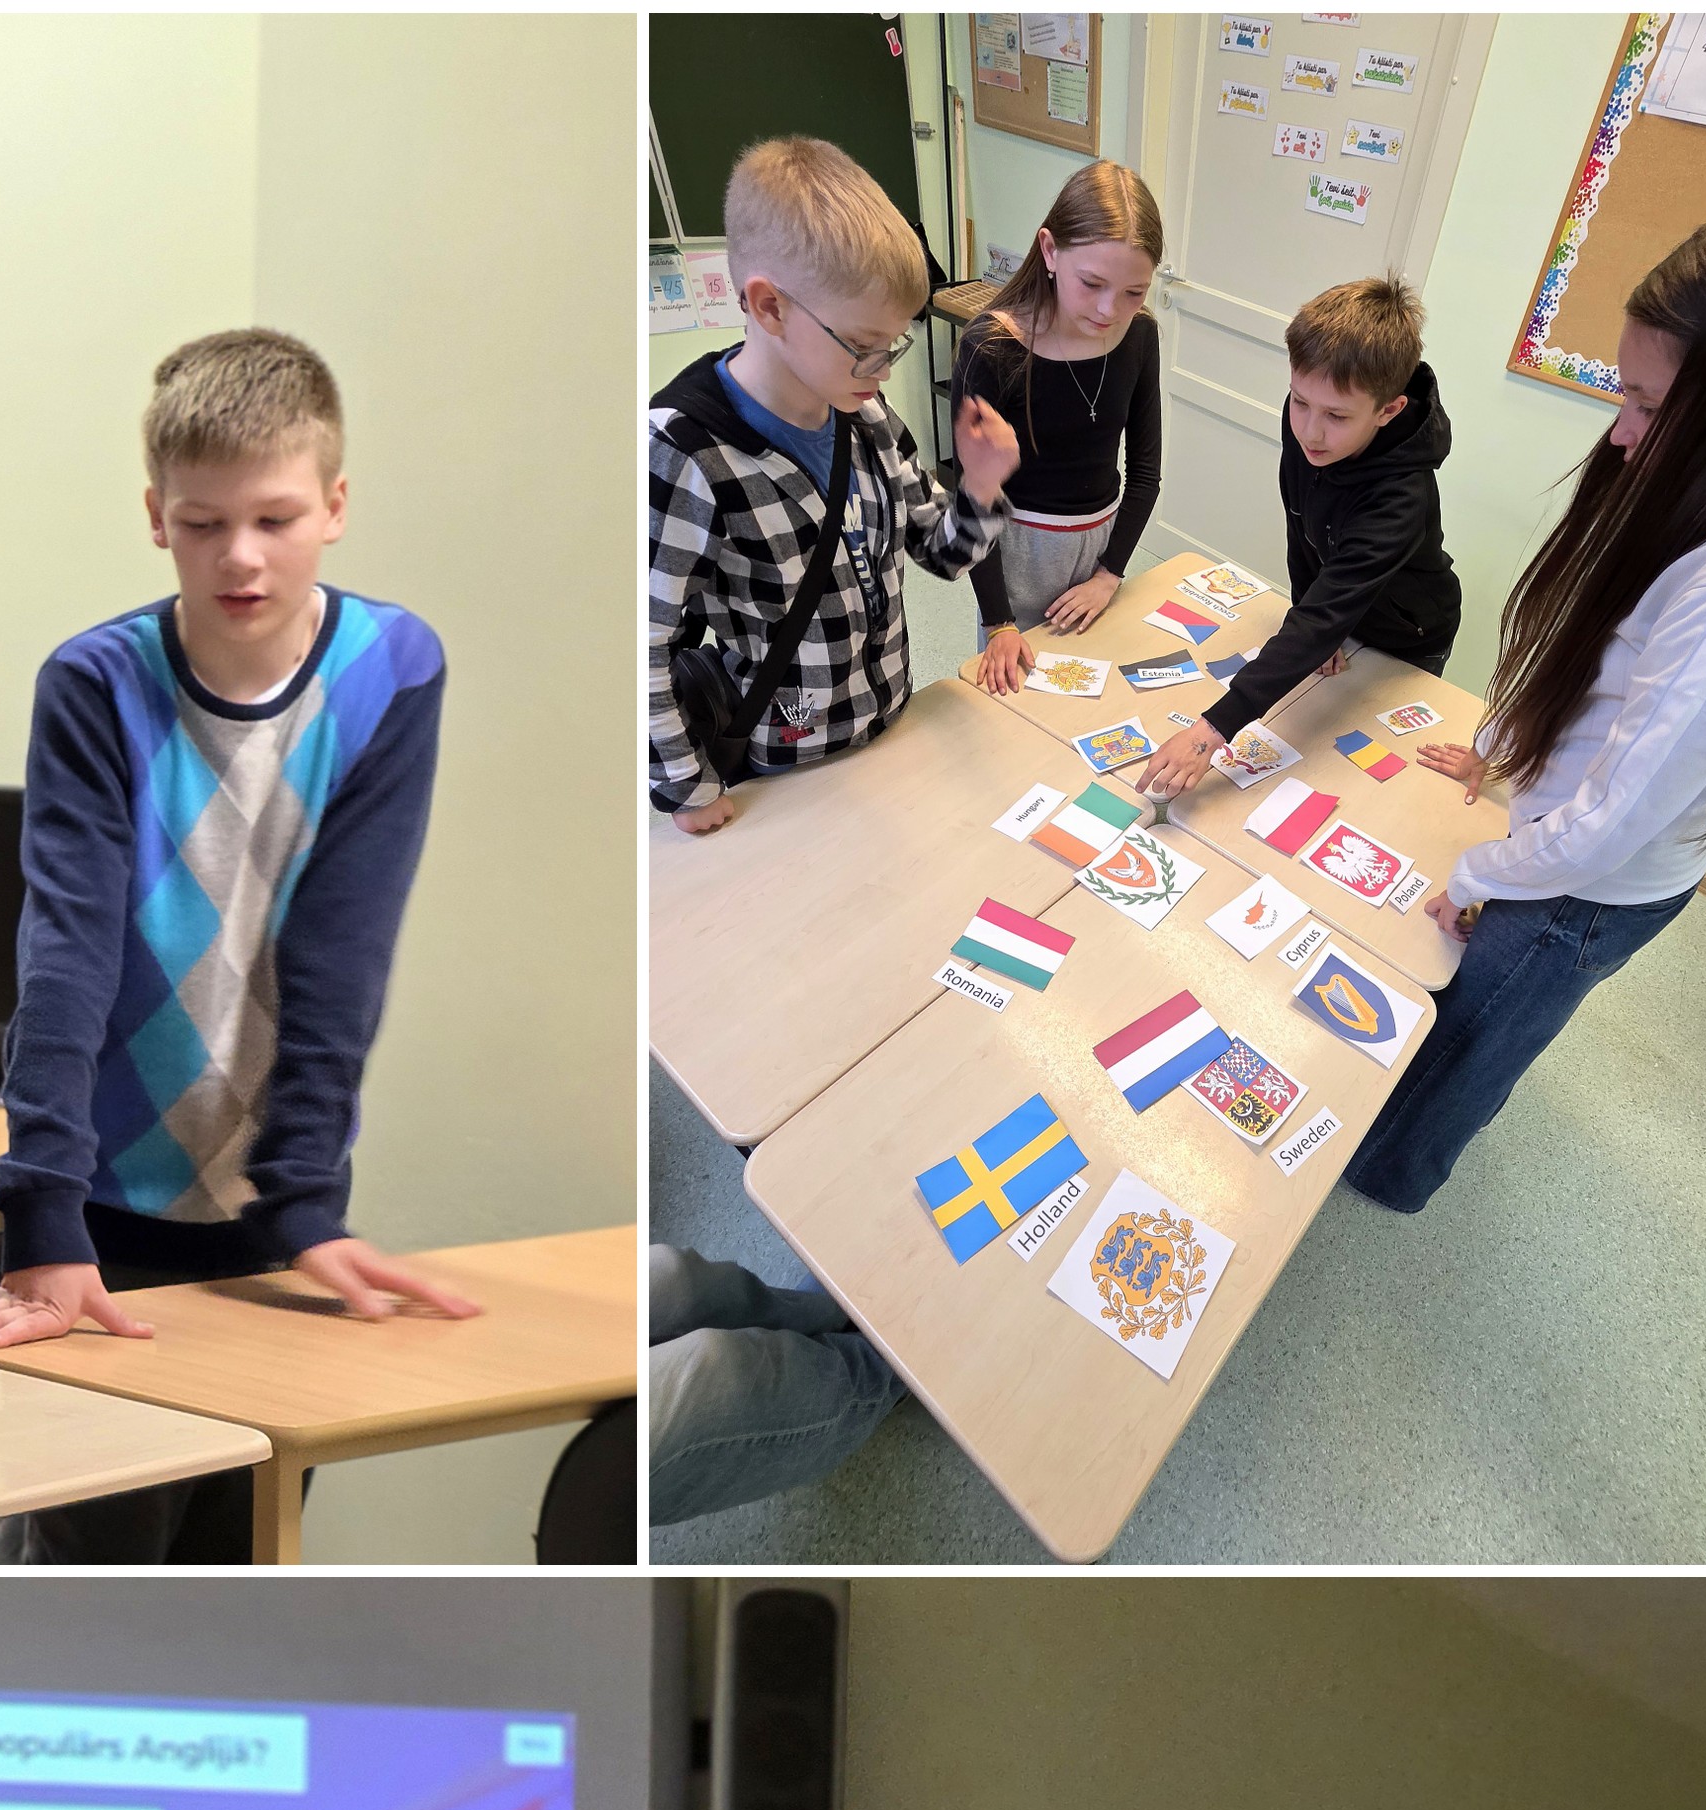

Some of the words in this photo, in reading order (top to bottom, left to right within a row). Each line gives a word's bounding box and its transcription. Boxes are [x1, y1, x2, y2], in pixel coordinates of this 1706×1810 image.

[1325, 180, 1340, 193] Tevi
[665, 280, 682, 295] 45
[708, 278, 721, 294] 15
[1180, 585, 1213, 606] Republic
[1212, 603, 1236, 619] Czech
[1015, 796, 1046, 823] Hungary
[1394, 877, 1426, 909] Poland
[1284, 927, 1323, 965] Cyprus
[941, 966, 1005, 1010] Romania
[1278, 1114, 1338, 1168] Sweden
[1015, 1179, 1083, 1253] Holland
